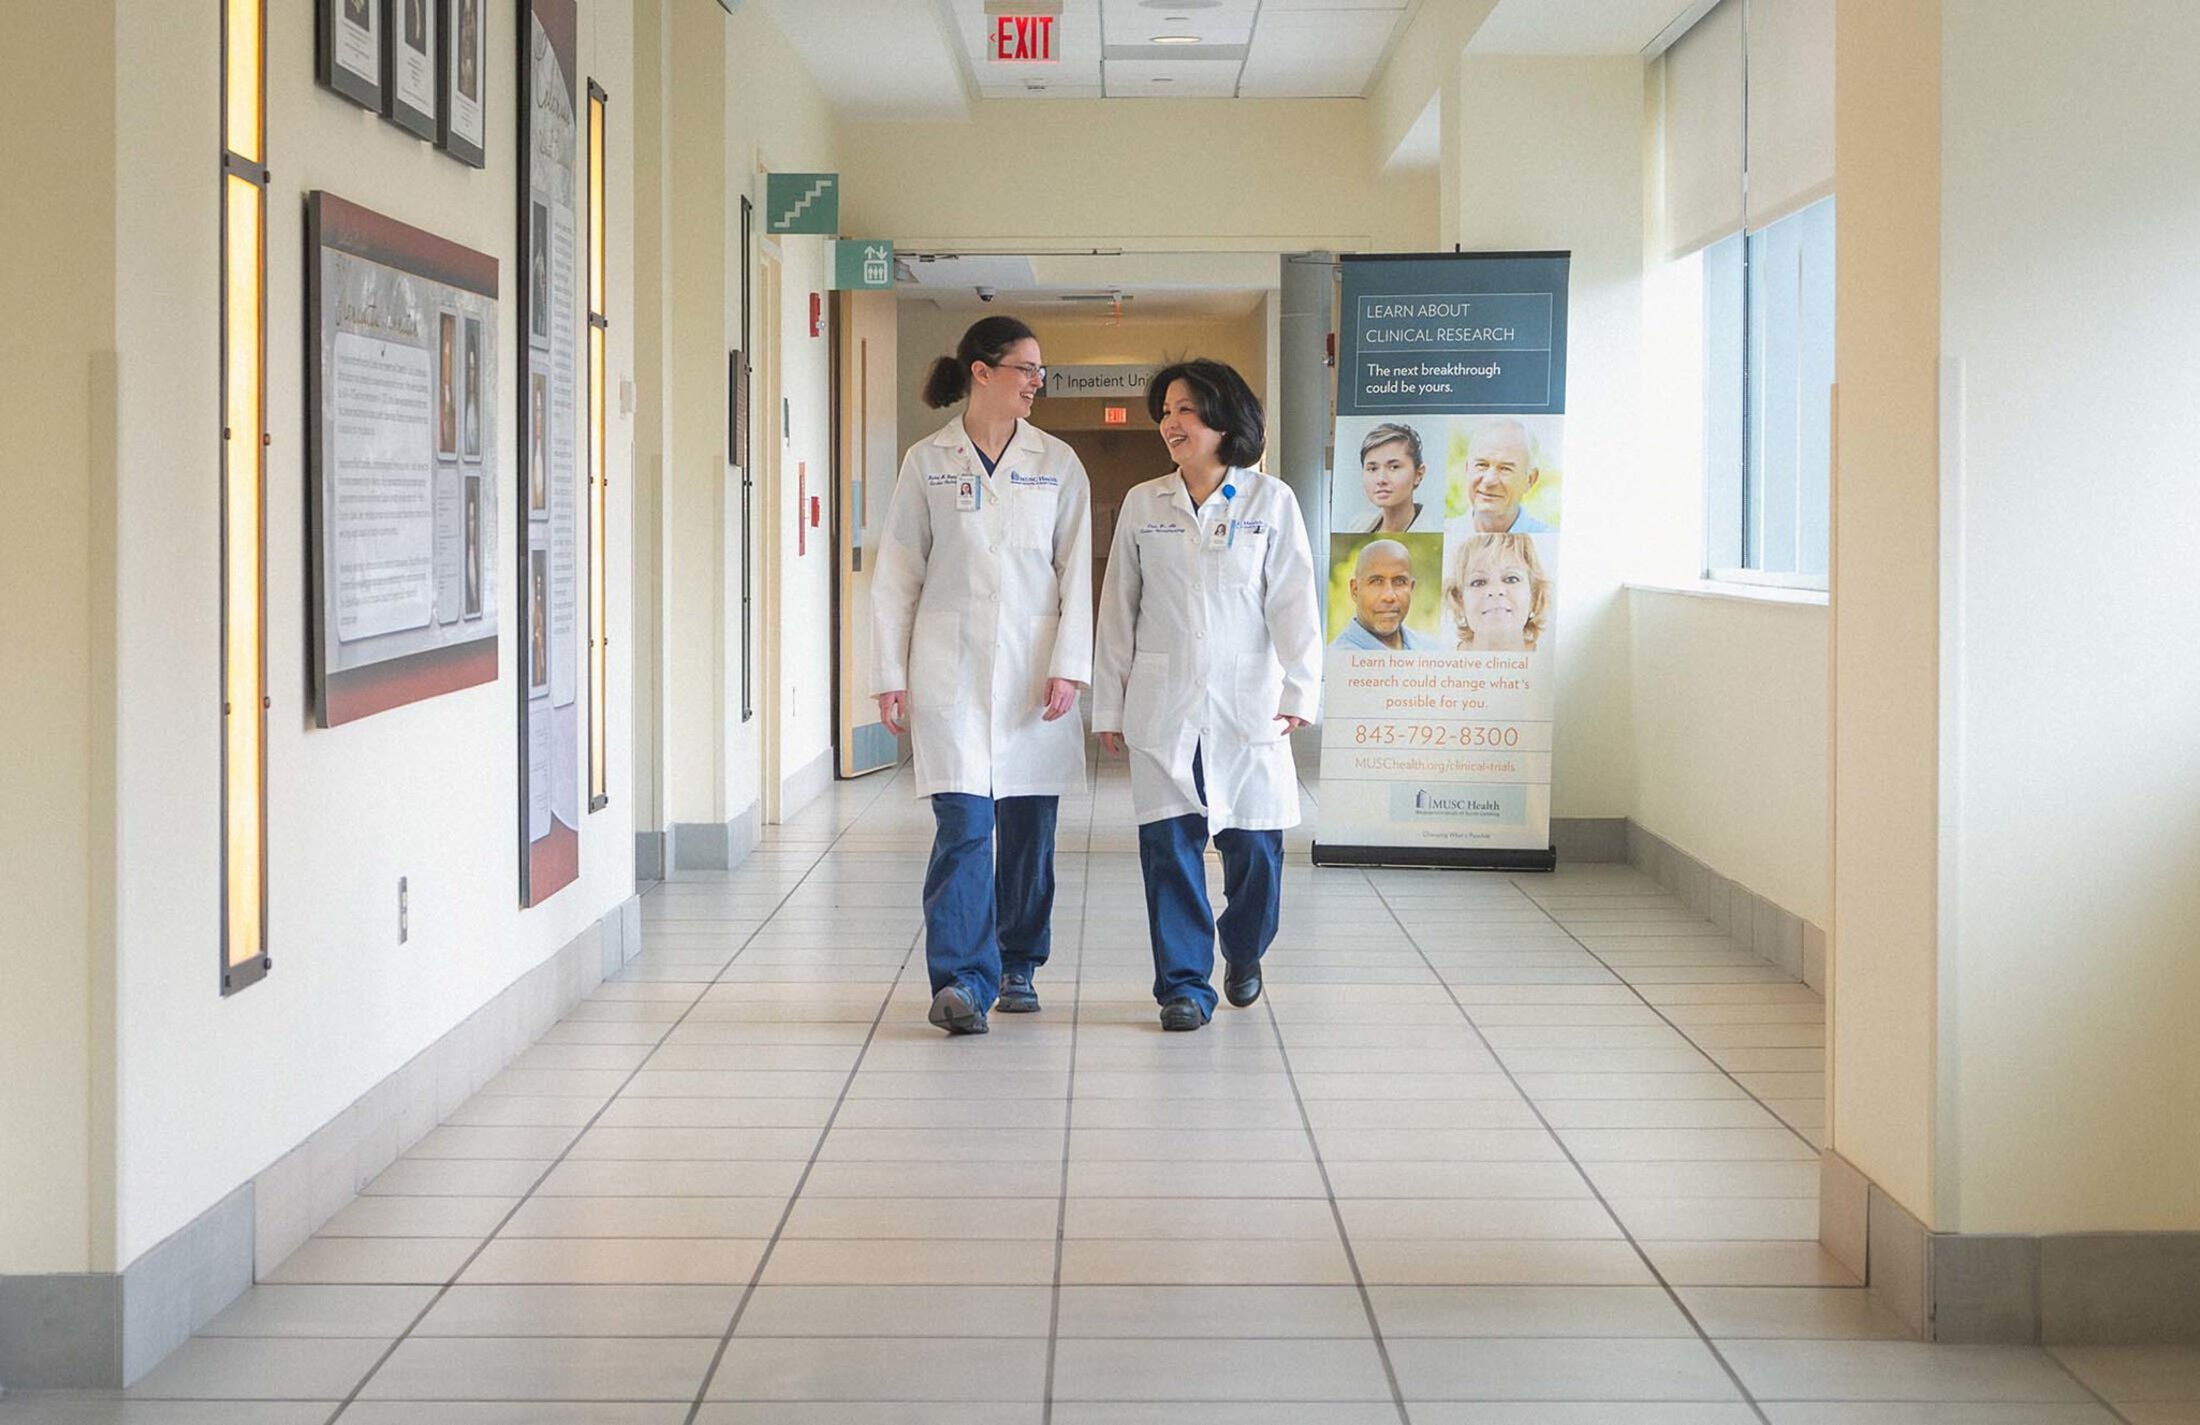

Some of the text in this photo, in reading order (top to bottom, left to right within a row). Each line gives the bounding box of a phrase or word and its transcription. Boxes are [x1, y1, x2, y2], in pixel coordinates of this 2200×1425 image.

[998, 16, 1054, 59] EXIT
[1366, 303, 1471, 319] LEARN ABOUT
[1366, 327, 1515, 343] CLINICAL RESEARCH
[1367, 361, 1501, 379] The next breakthrough
[1068, 374, 1149, 391] Inpatient Uni
[1366, 379, 1453, 396] could be yours.
[1351, 655, 1528, 670] Learn how innovative clinical
[1348, 675, 1530, 692] research could change what's
[1386, 694, 1488, 711] possible for you.
[1355, 724, 1519, 747] 843-792-8300
[1354, 756, 1515, 774] MUSChealth.org/clinical-trials
[1432, 799, 1500, 811] MUSC Health
